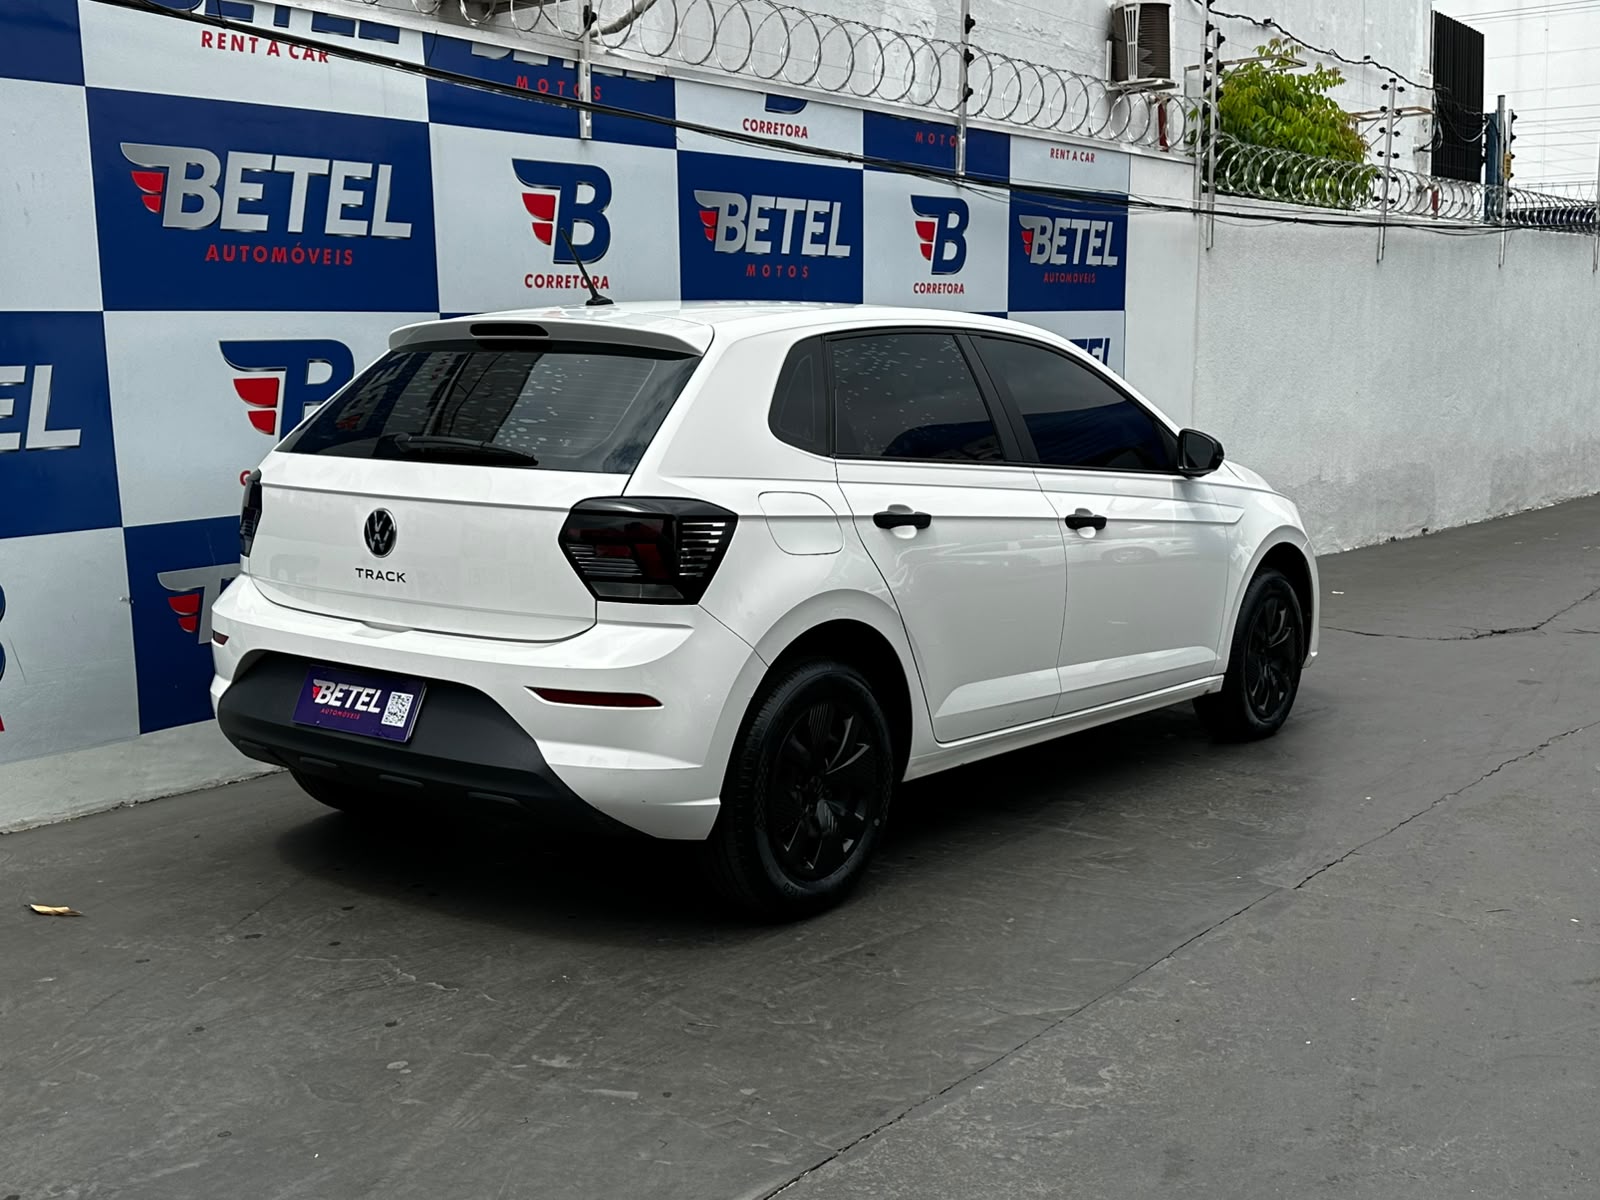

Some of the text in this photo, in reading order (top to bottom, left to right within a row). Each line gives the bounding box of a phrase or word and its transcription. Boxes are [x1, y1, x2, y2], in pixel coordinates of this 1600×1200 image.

[201, 30, 259, 54] RENT
[266, 39, 281, 57] A
[742, 118, 808, 139] CORRETORA
[1050, 147, 1095, 163] RENT A CAR
[120, 142, 413, 239] BETEL
[693, 190, 852, 258] BETEL
[1018, 214, 1119, 267] BETEL
[205, 243, 354, 266] AUTOMÓVEIS
[524, 273, 610, 290] CORRETORA
[745, 263, 810, 279] MOTOS
[913, 282, 965, 295] CORRETORA
[355, 567, 407, 584] TRACK
[312, 679, 382, 714] BETEL
